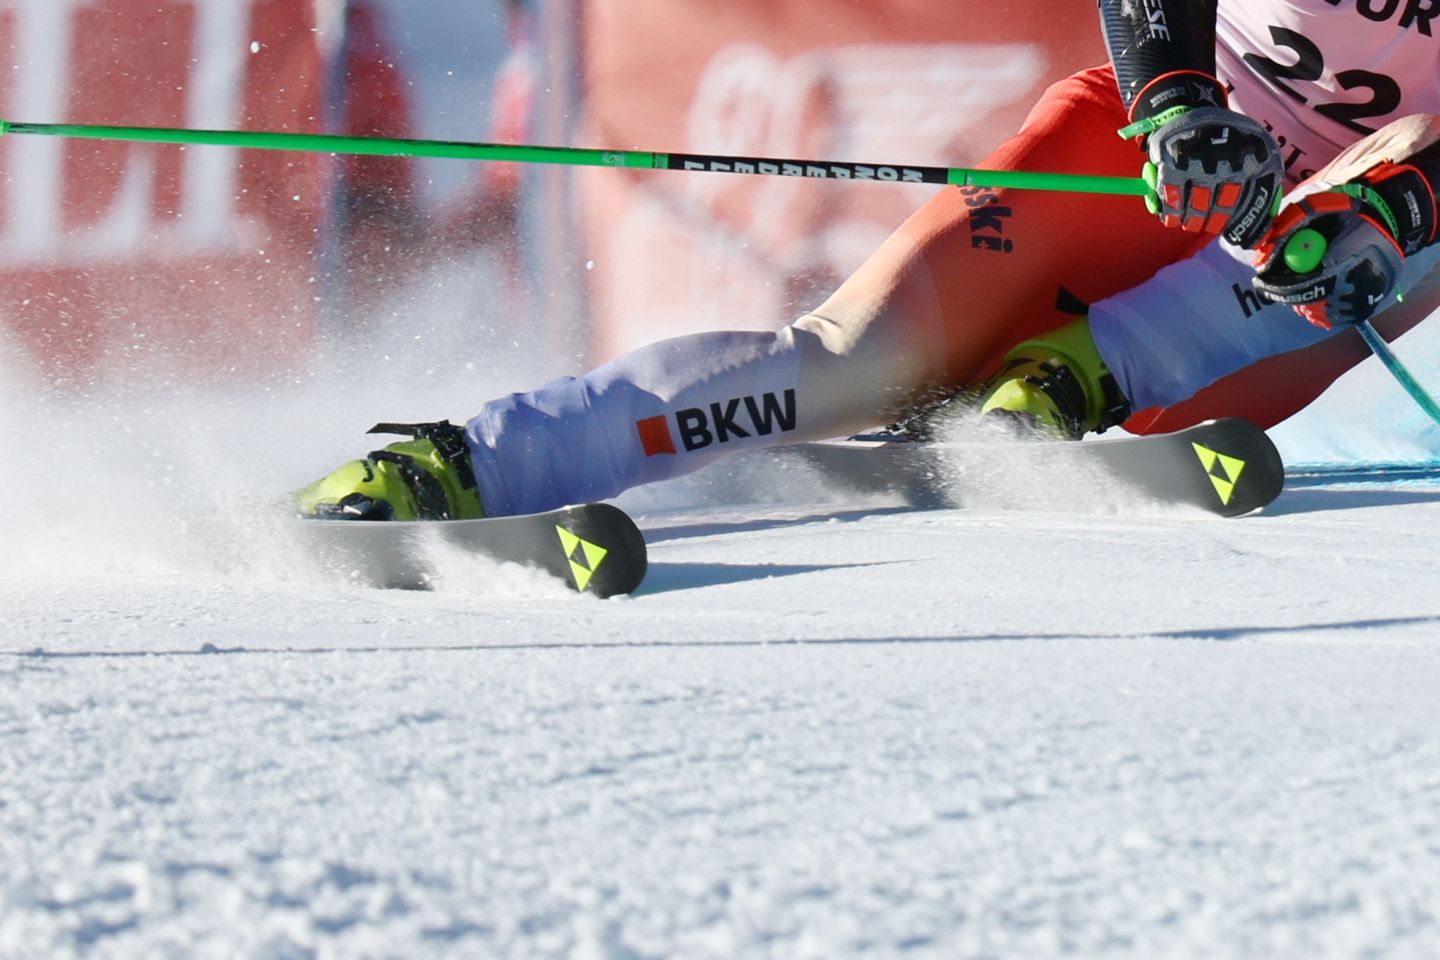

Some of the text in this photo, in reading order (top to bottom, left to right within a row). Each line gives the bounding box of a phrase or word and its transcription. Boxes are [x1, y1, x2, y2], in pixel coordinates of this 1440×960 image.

[1243, 25, 1402, 138] 22
[1229, 186, 1269, 242] reusch
[1264, 286, 1326, 303] reusch
[675, 388, 797, 452] BKW
